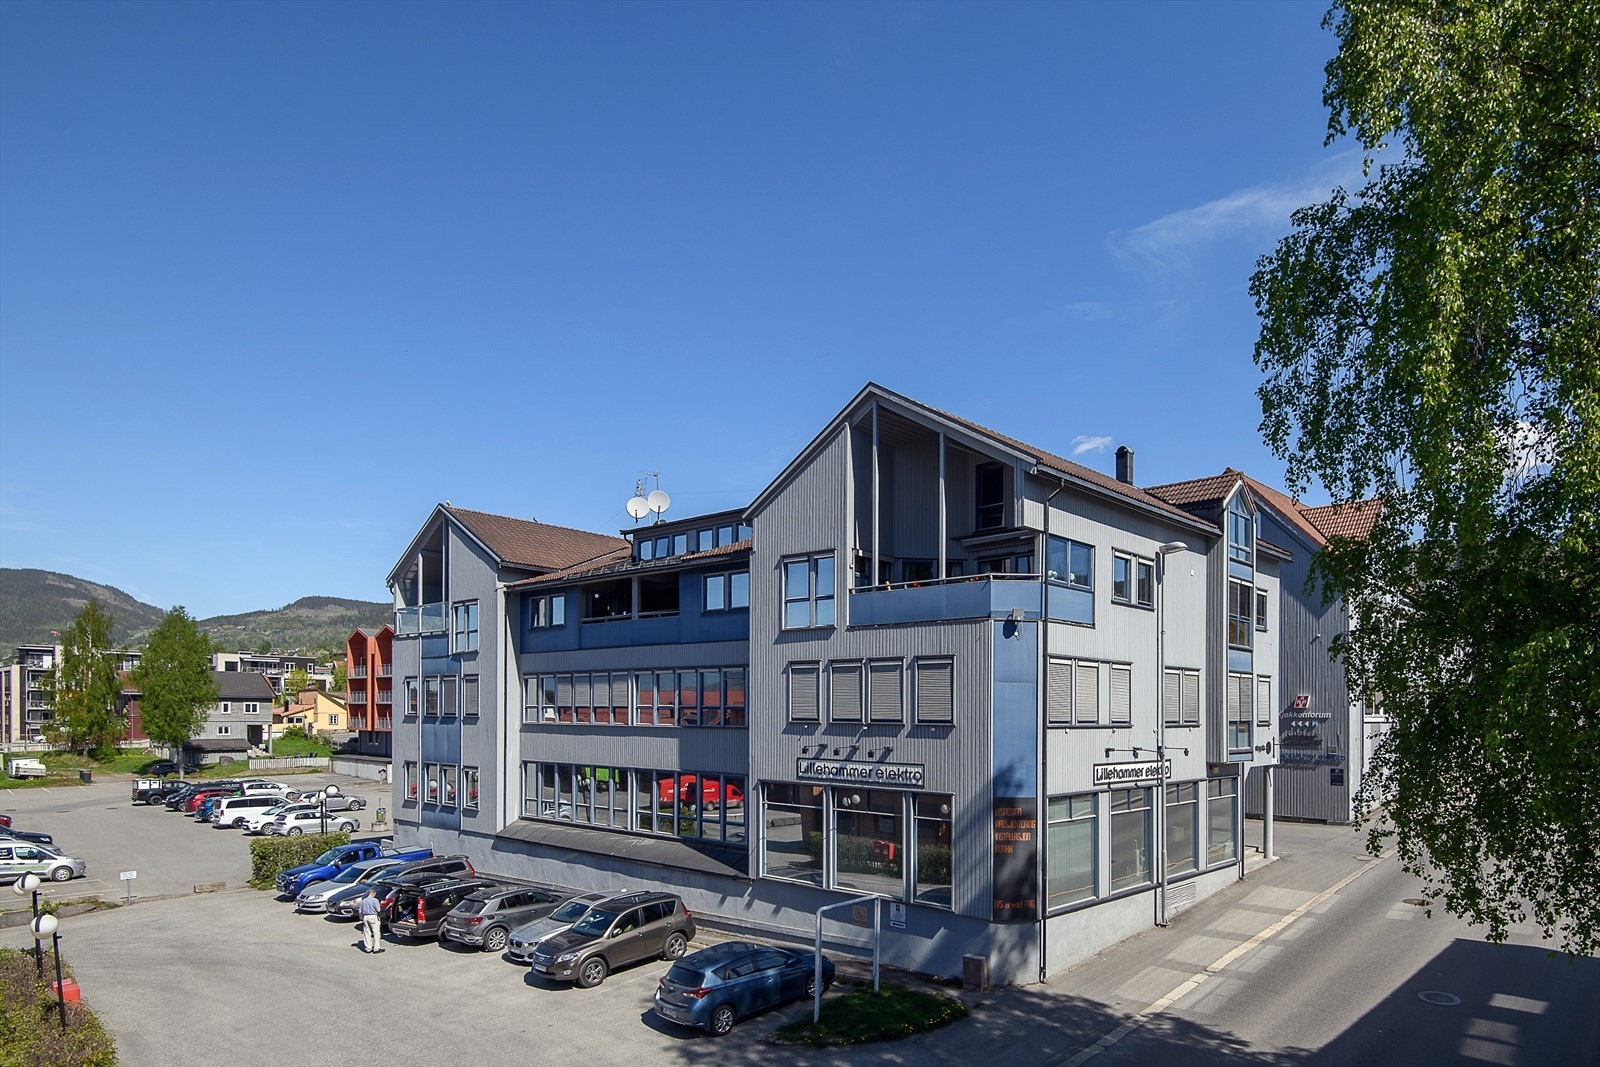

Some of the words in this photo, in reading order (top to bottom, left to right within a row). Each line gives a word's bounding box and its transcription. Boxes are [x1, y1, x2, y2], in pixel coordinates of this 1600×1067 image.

[799, 762, 873, 778] Lillehammer
[876, 768, 922, 782] elektro
[1096, 766, 1144, 781] Lillehammer
